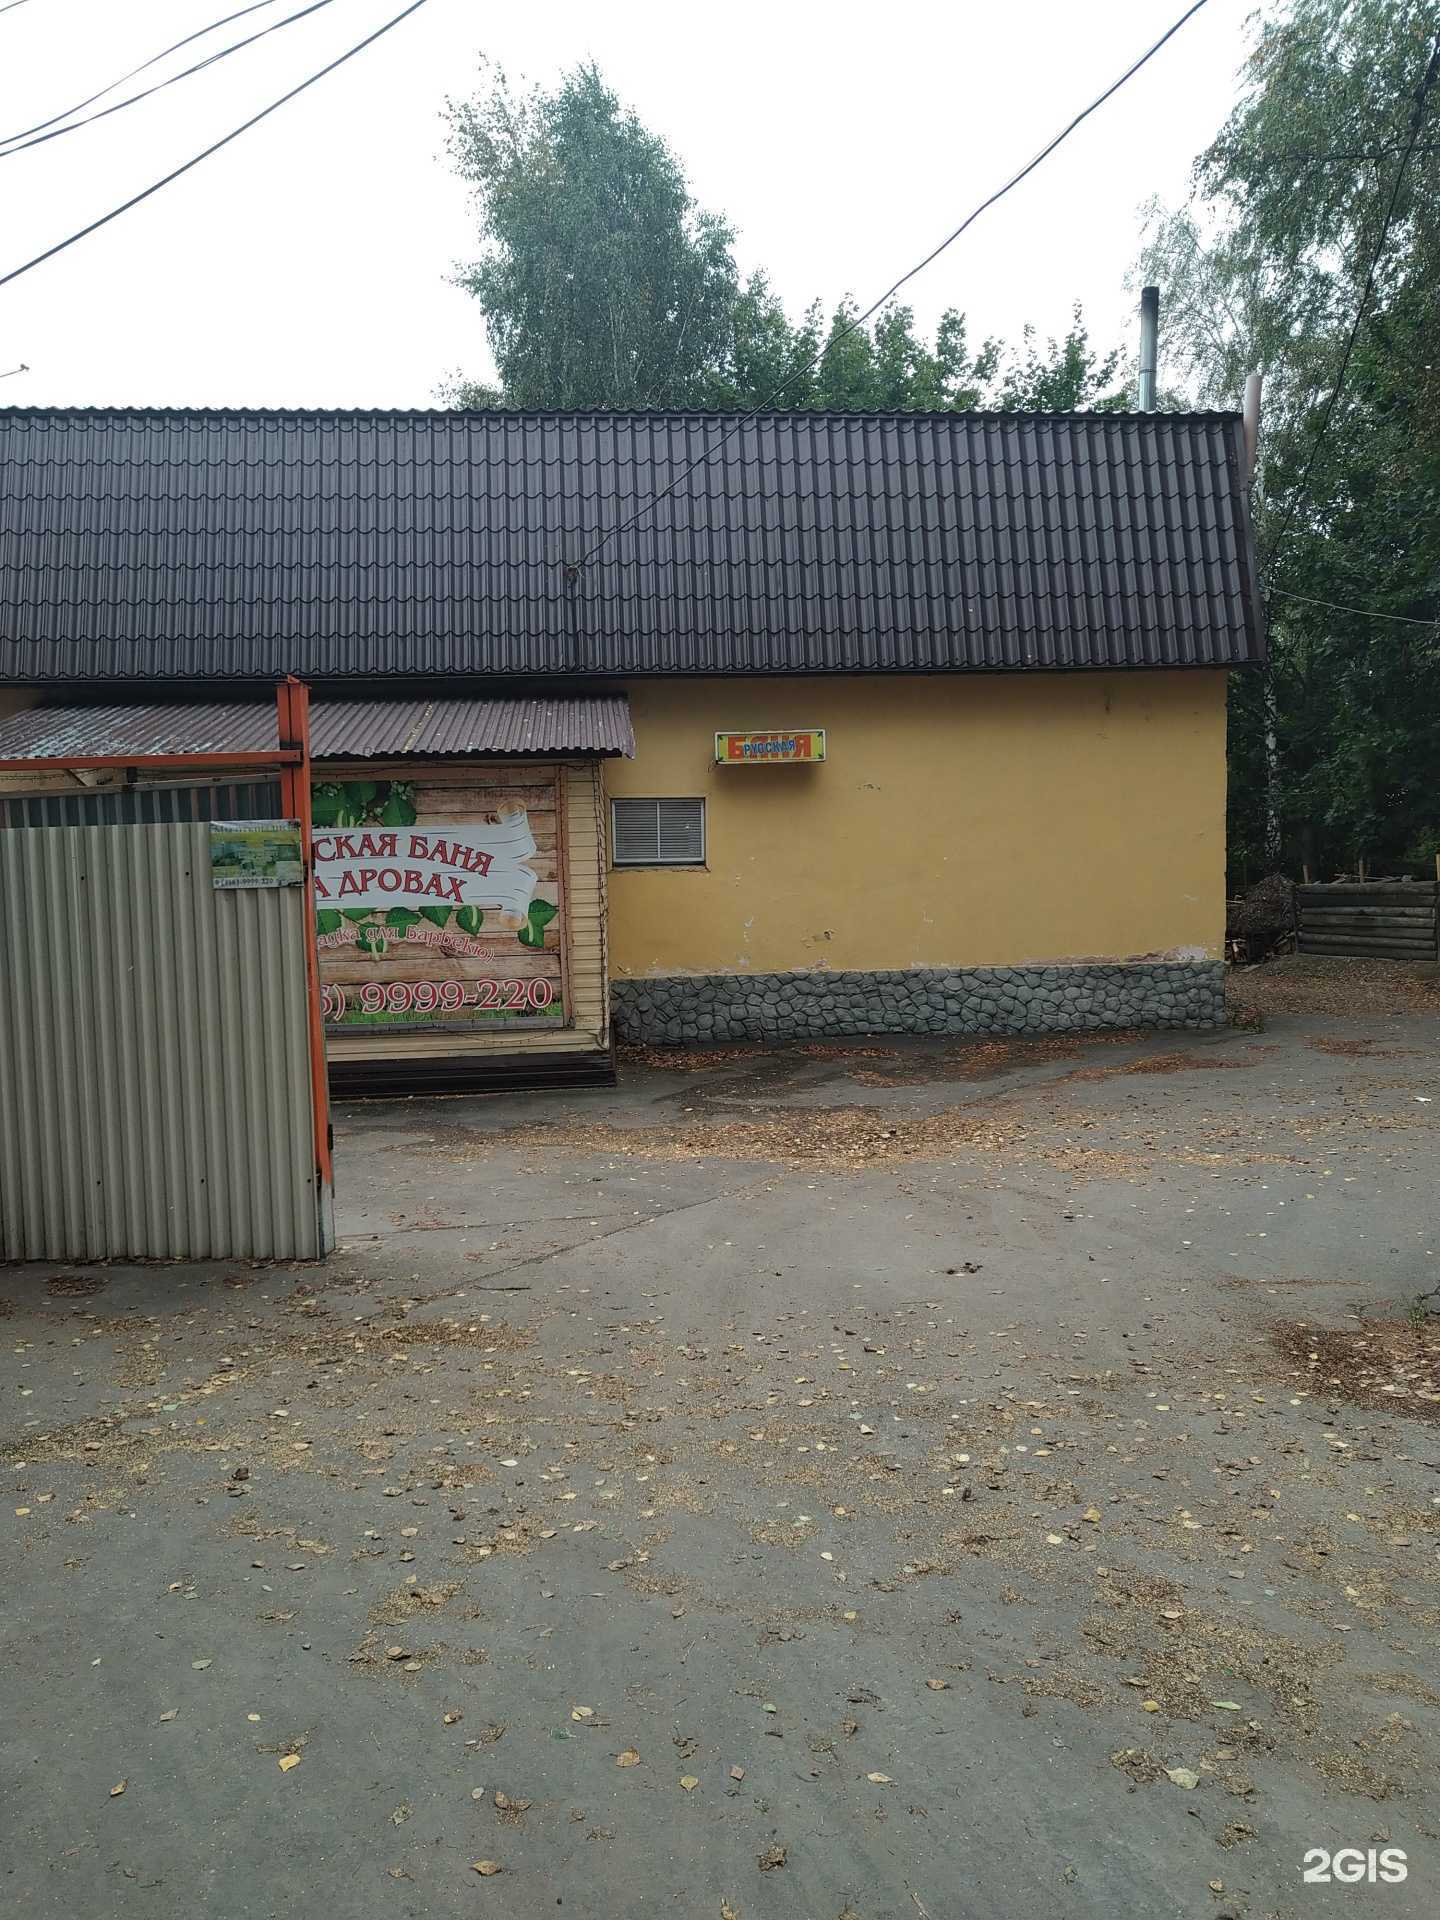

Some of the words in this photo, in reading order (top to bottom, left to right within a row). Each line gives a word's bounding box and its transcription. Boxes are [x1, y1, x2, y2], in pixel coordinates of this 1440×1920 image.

[408, 835, 495, 877] БАНЯ
[338, 868, 467, 903] ДРОВАХ
[365, 927, 400, 943] для
[360, 977, 553, 1014] 9999-220
